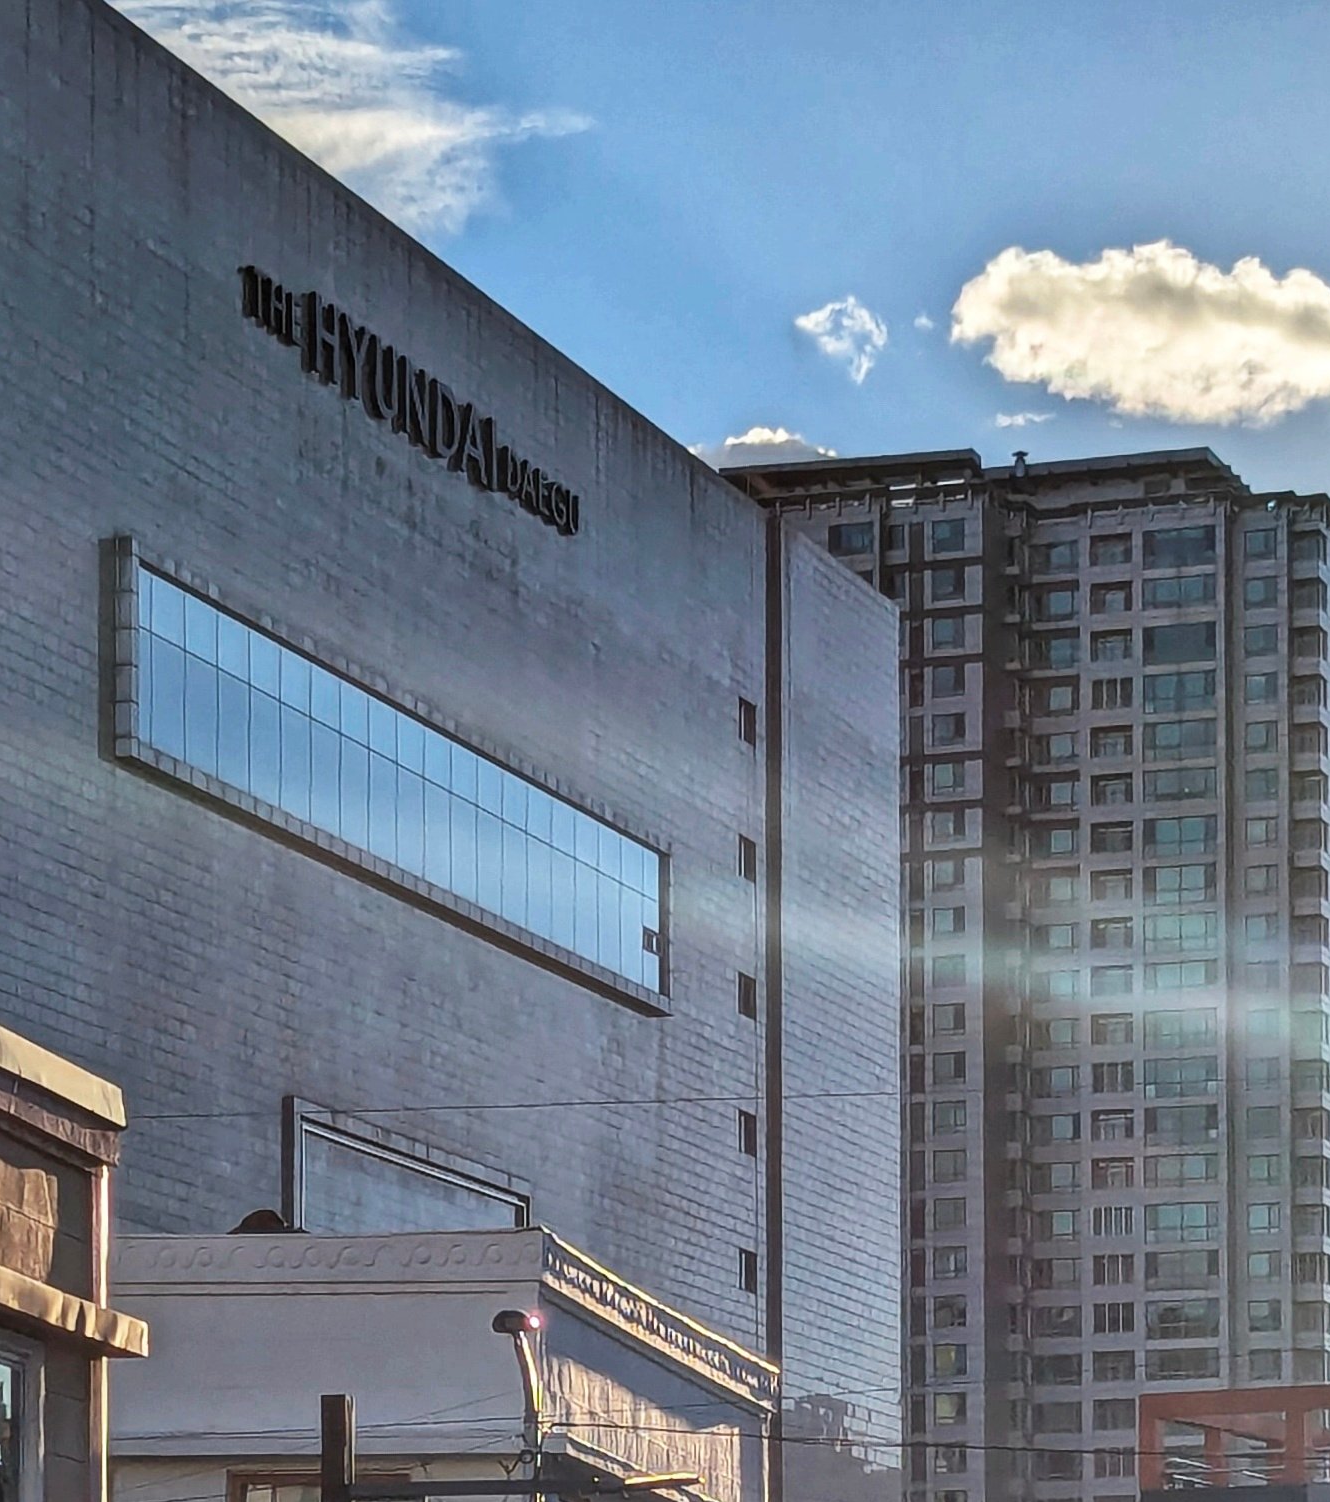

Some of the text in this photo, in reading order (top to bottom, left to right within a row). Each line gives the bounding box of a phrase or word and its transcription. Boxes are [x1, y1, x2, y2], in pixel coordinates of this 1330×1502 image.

[237, 264, 580, 537] THE HYUNDAI DAEGU
